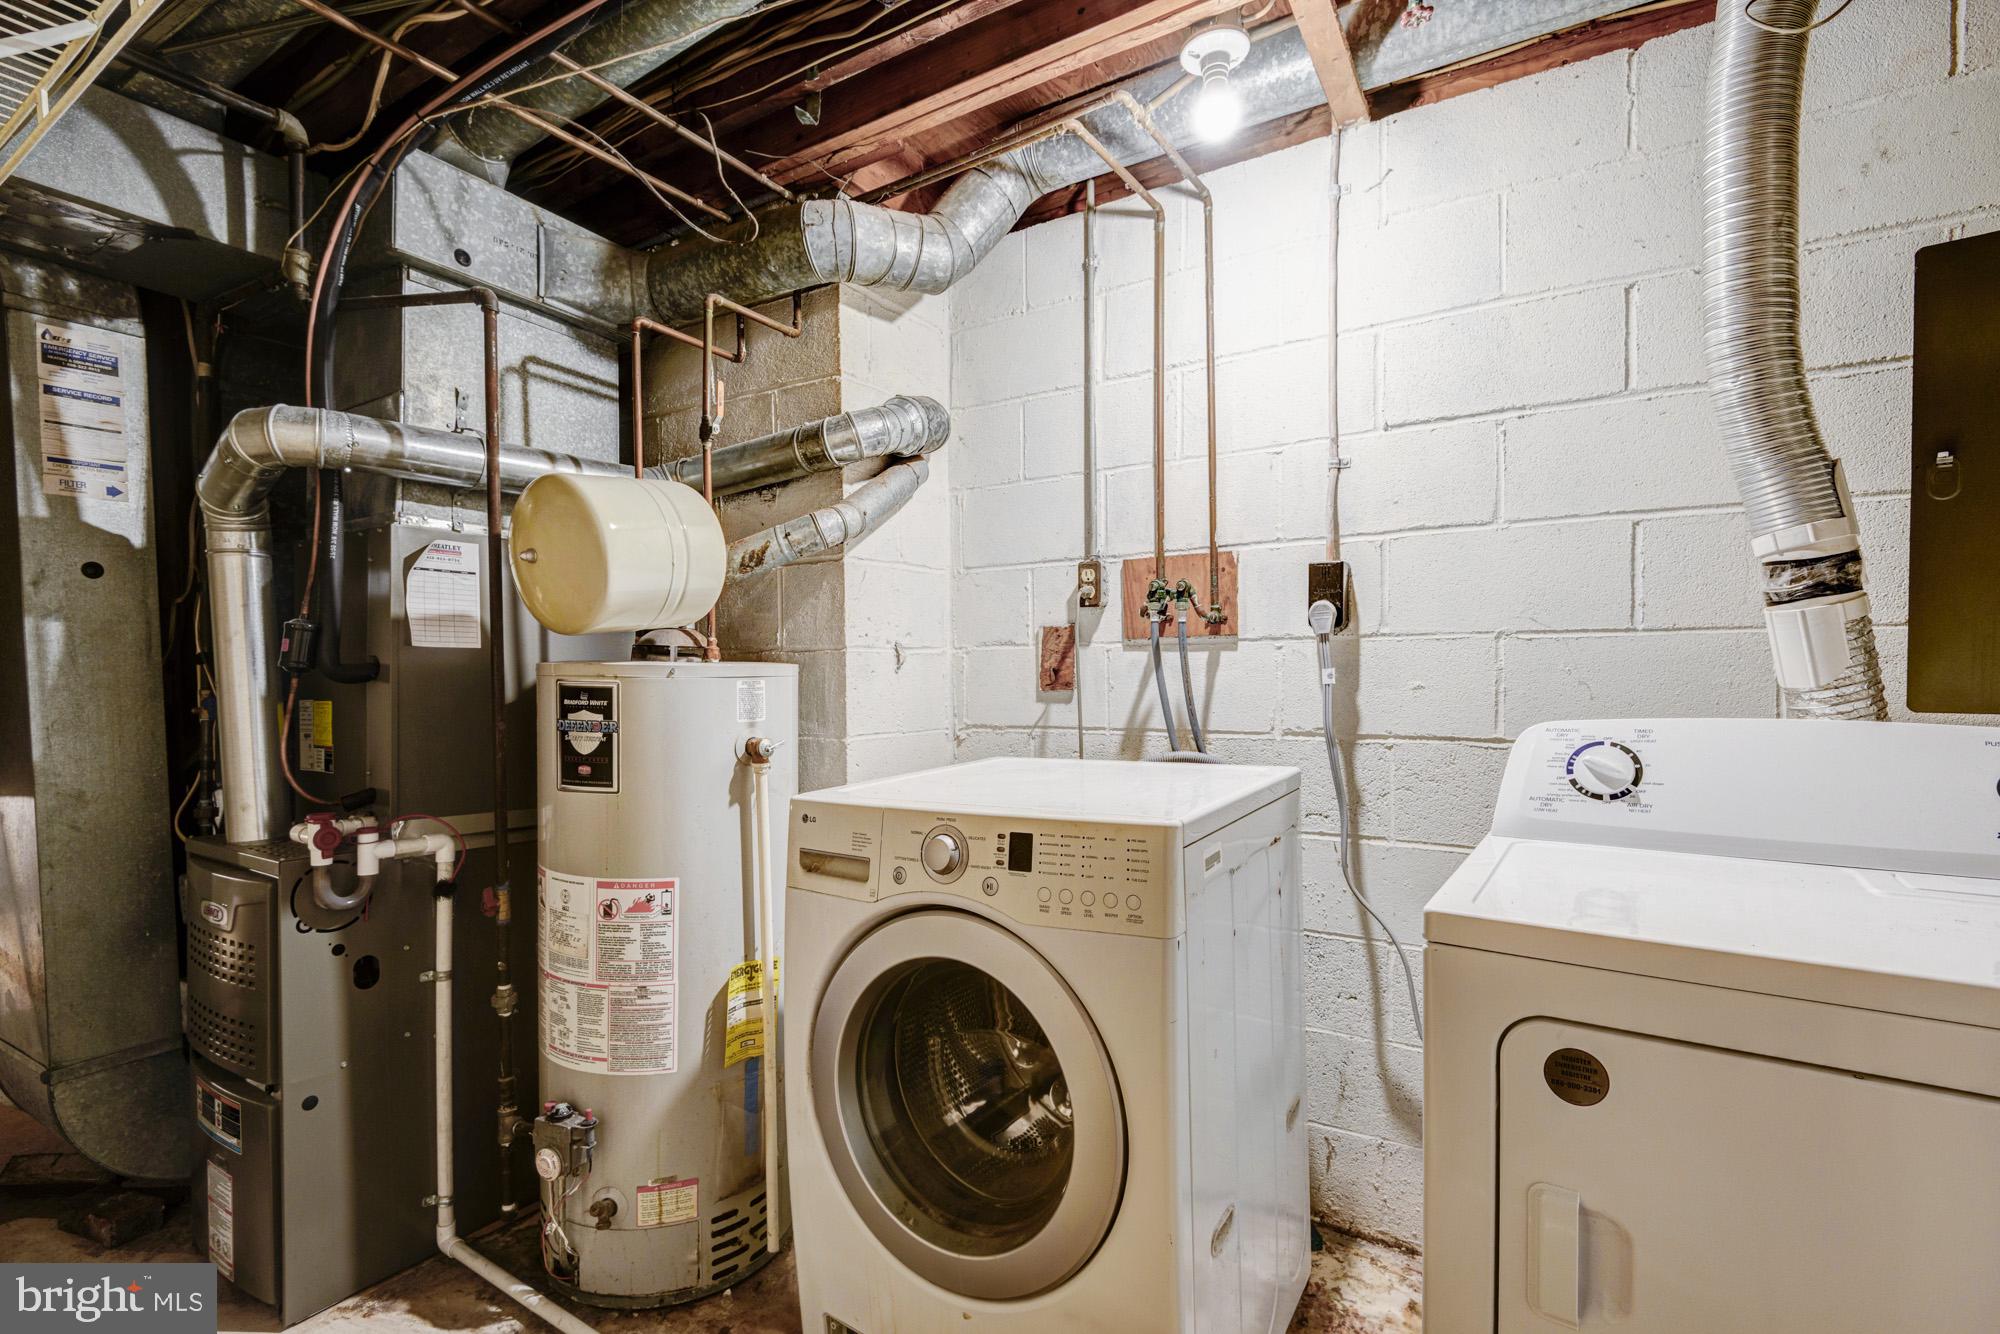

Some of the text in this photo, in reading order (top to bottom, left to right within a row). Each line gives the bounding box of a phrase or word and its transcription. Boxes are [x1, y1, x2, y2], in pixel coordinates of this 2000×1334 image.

[501, 60, 531, 81] RETARDANT
[43, 343, 87, 357] EMERGENCY
[88, 352, 116, 363] SERVICE
[52, 386, 113, 402] SERVICE RECORD
[59, 478, 87, 489] FILTER
[558, 719, 619, 734] DEFENDER
